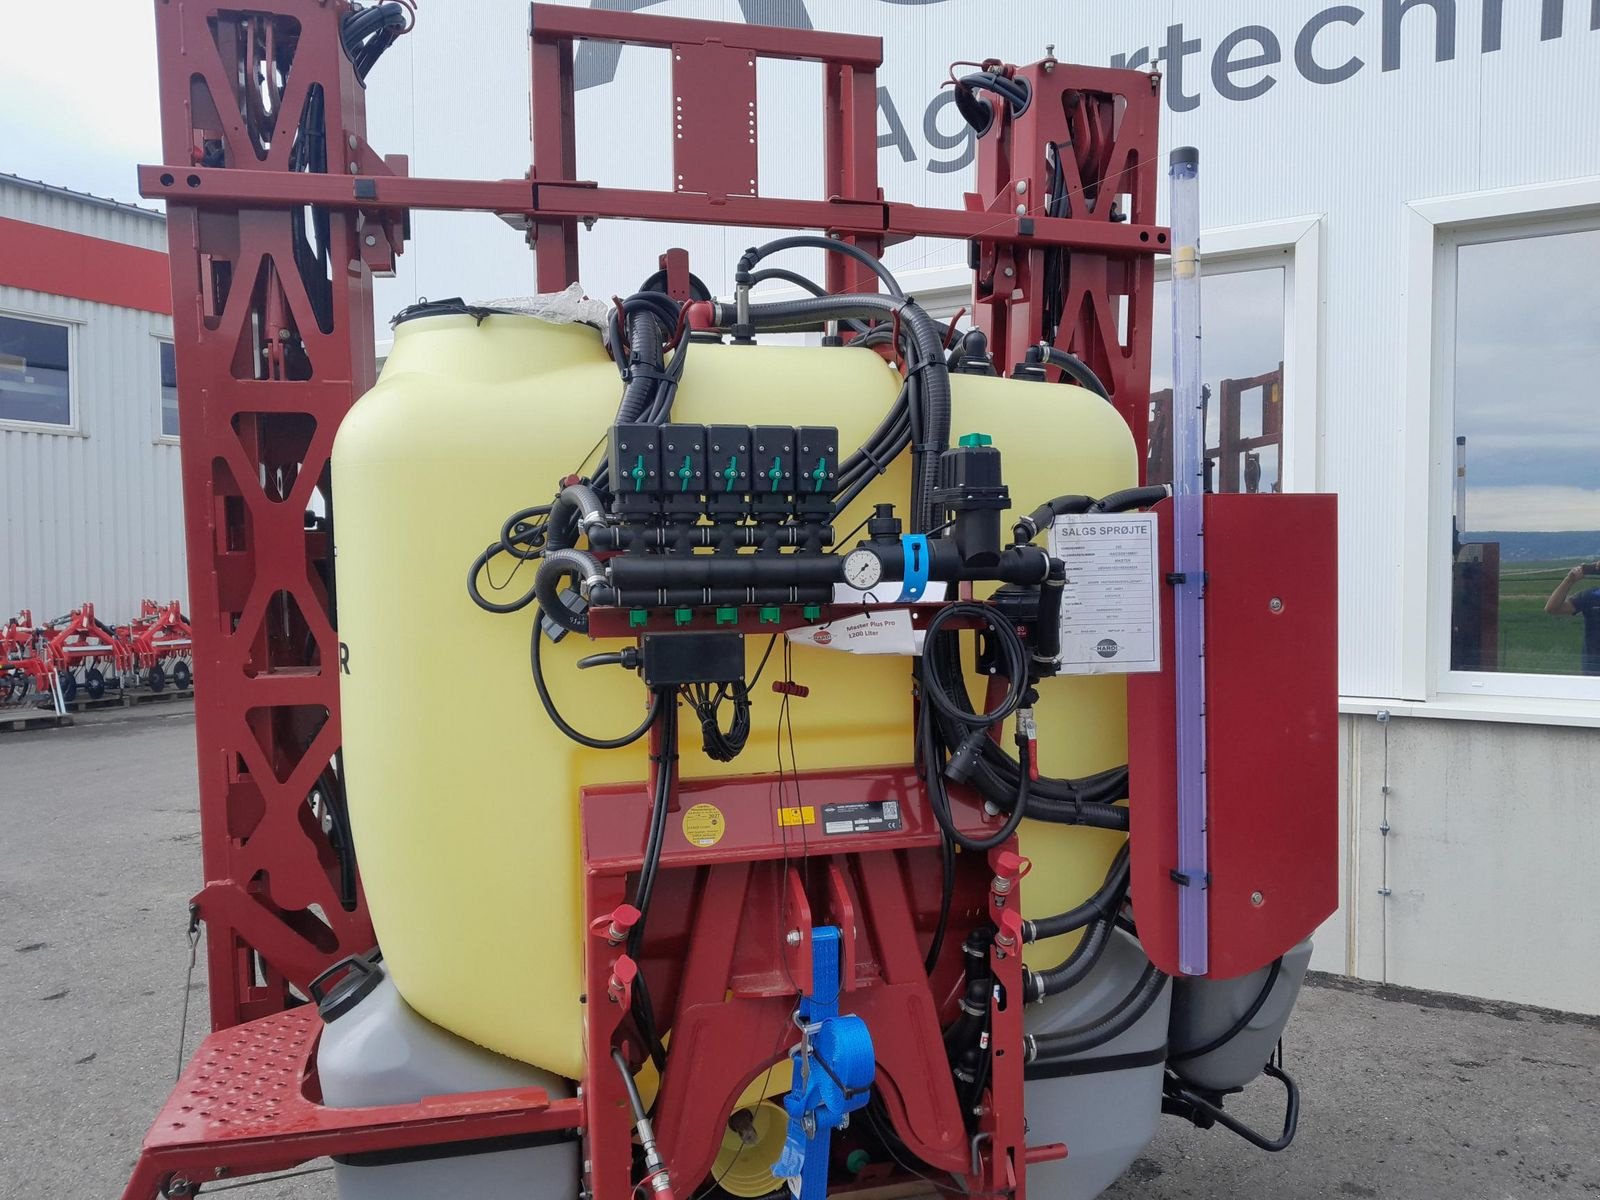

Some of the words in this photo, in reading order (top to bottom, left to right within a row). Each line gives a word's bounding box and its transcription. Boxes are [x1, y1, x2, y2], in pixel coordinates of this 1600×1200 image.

[1061, 526, 1097, 537] SALGS
[1099, 525, 1148, 535] SPRØJTE
[846, 622, 869, 631] Master
[848, 631, 864, 639] 1200
